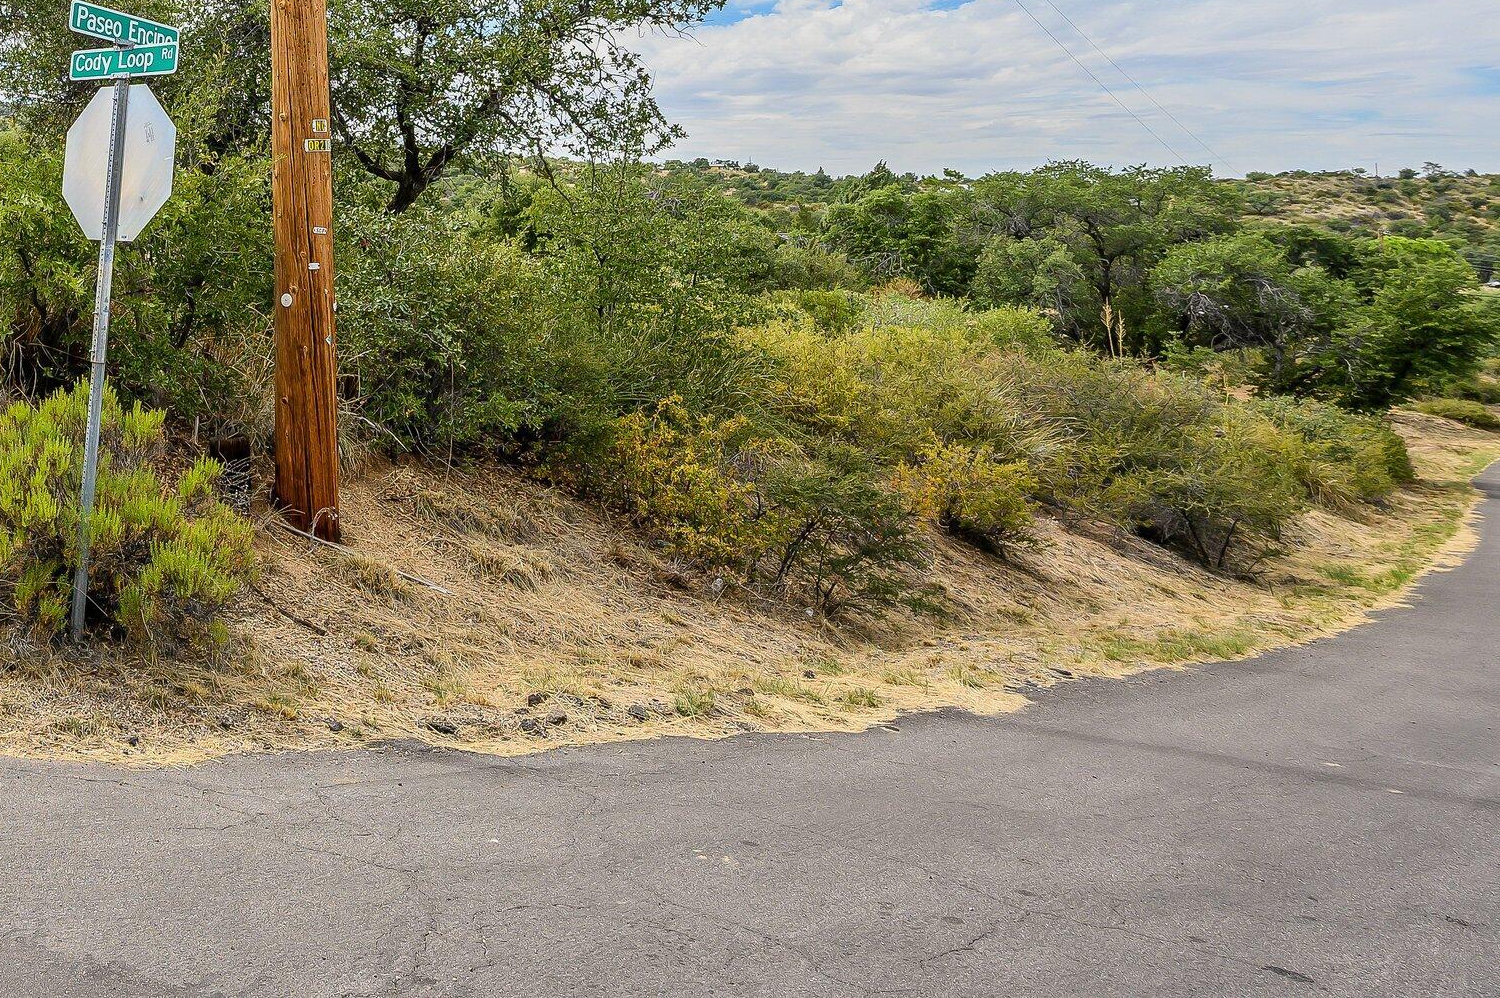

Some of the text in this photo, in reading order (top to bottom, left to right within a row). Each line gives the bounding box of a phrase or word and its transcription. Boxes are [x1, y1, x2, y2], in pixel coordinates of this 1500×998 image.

[77, 5, 122, 38] Paseo
[75, 47, 174, 75] Cody Loop Rd
